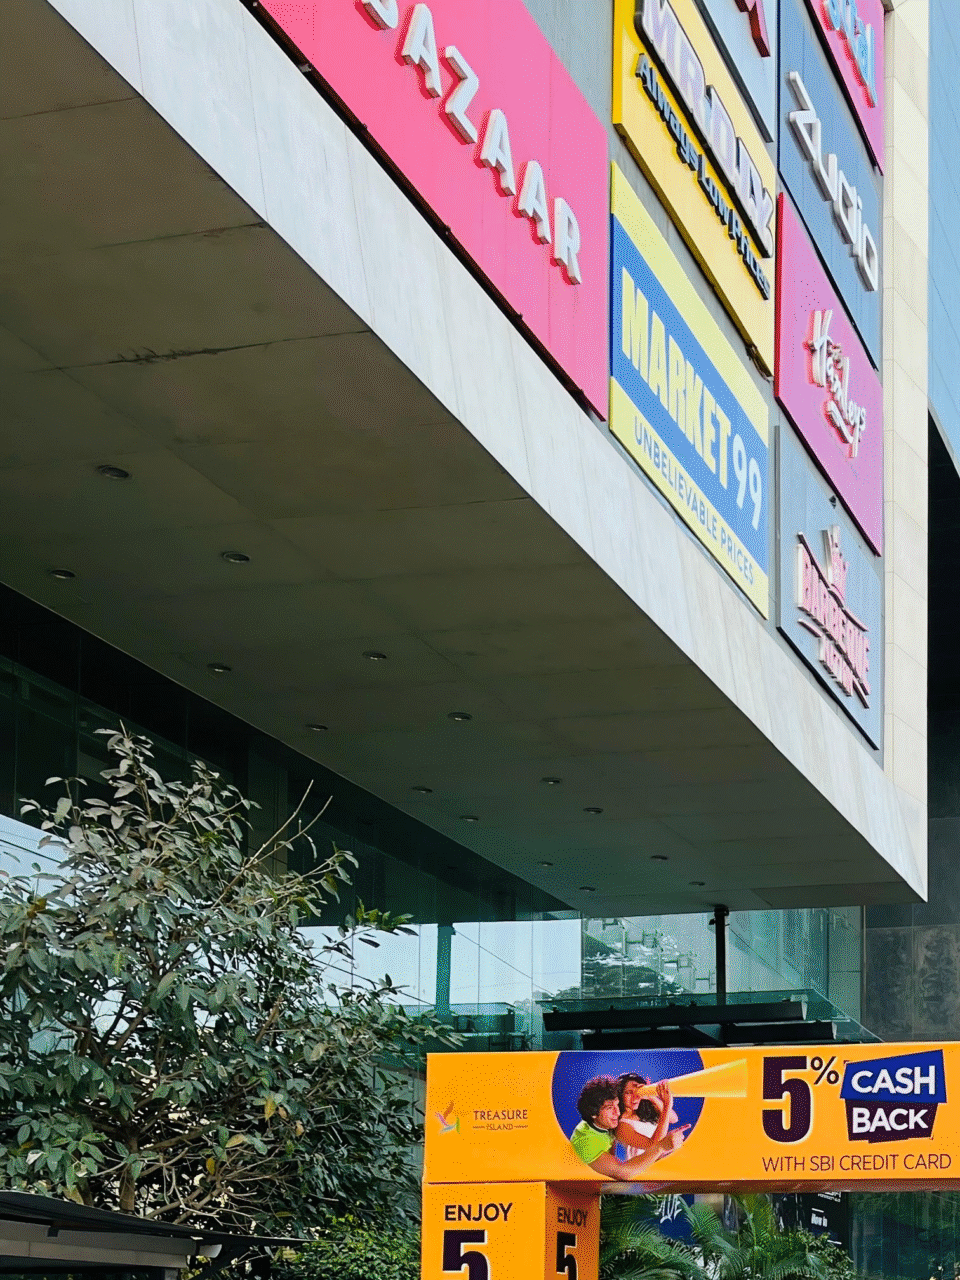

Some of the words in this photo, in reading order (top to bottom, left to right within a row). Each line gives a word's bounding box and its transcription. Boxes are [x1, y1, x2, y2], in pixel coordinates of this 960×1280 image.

[634, 414, 717, 541] UNBELIEVABLE
[720, 532, 754, 586] PRICES
[851, 1066, 936, 1095] CASH
[473, 1109, 528, 1121] TREASURE
[852, 1104, 928, 1134] BACK
[762, 1156, 806, 1172] WITH
[809, 1156, 835, 1171] SBI
[839, 1155, 899, 1171] CREDIT
[903, 1153, 952, 1169] CARD
[445, 1203, 513, 1222] ENJOY
[557, 1206, 588, 1228] ENJOY
